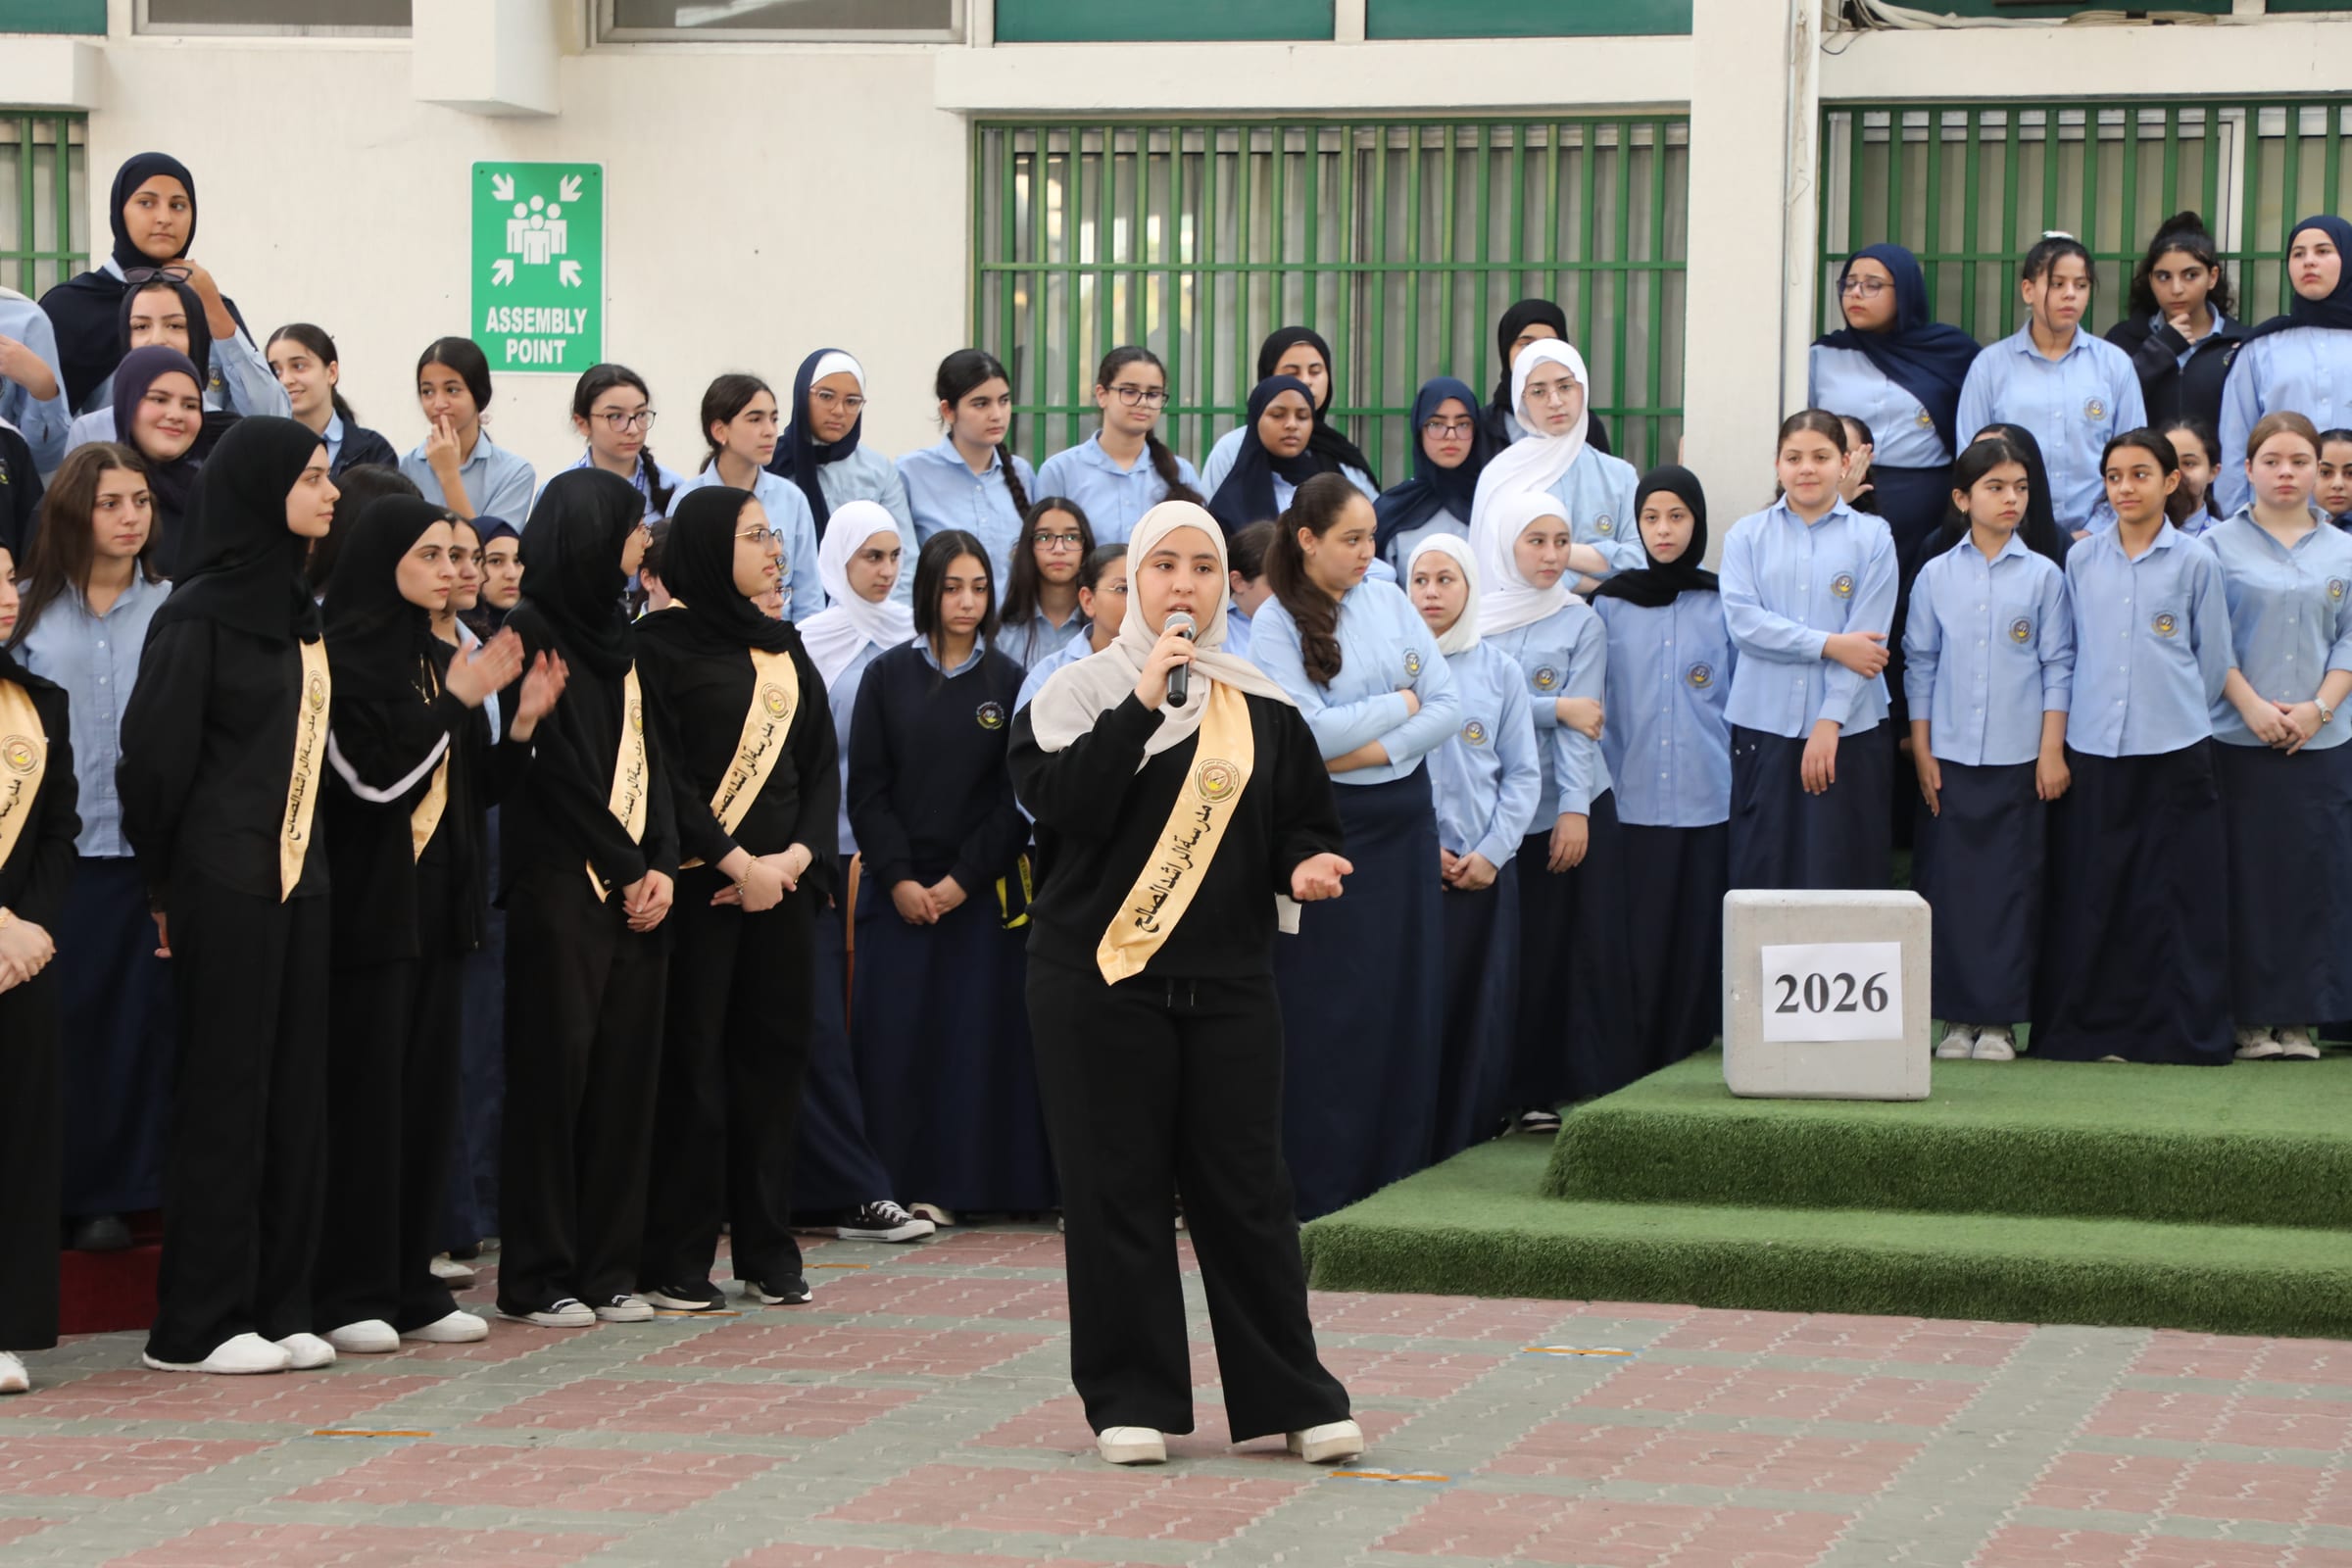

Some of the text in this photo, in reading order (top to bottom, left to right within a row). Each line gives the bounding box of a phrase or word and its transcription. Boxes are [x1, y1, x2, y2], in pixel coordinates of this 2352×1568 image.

[485, 306, 588, 334] ASSEMBLY
[506, 338, 566, 364] POINT
[743, 723, 774, 760] مدرسة
[731, 754, 758, 793] الراشد
[0, 779, 22, 817] مدرس
[1135, 805, 1212, 933] مدرسة الراشد الصالح
[1775, 971, 1888, 1013] 2026
